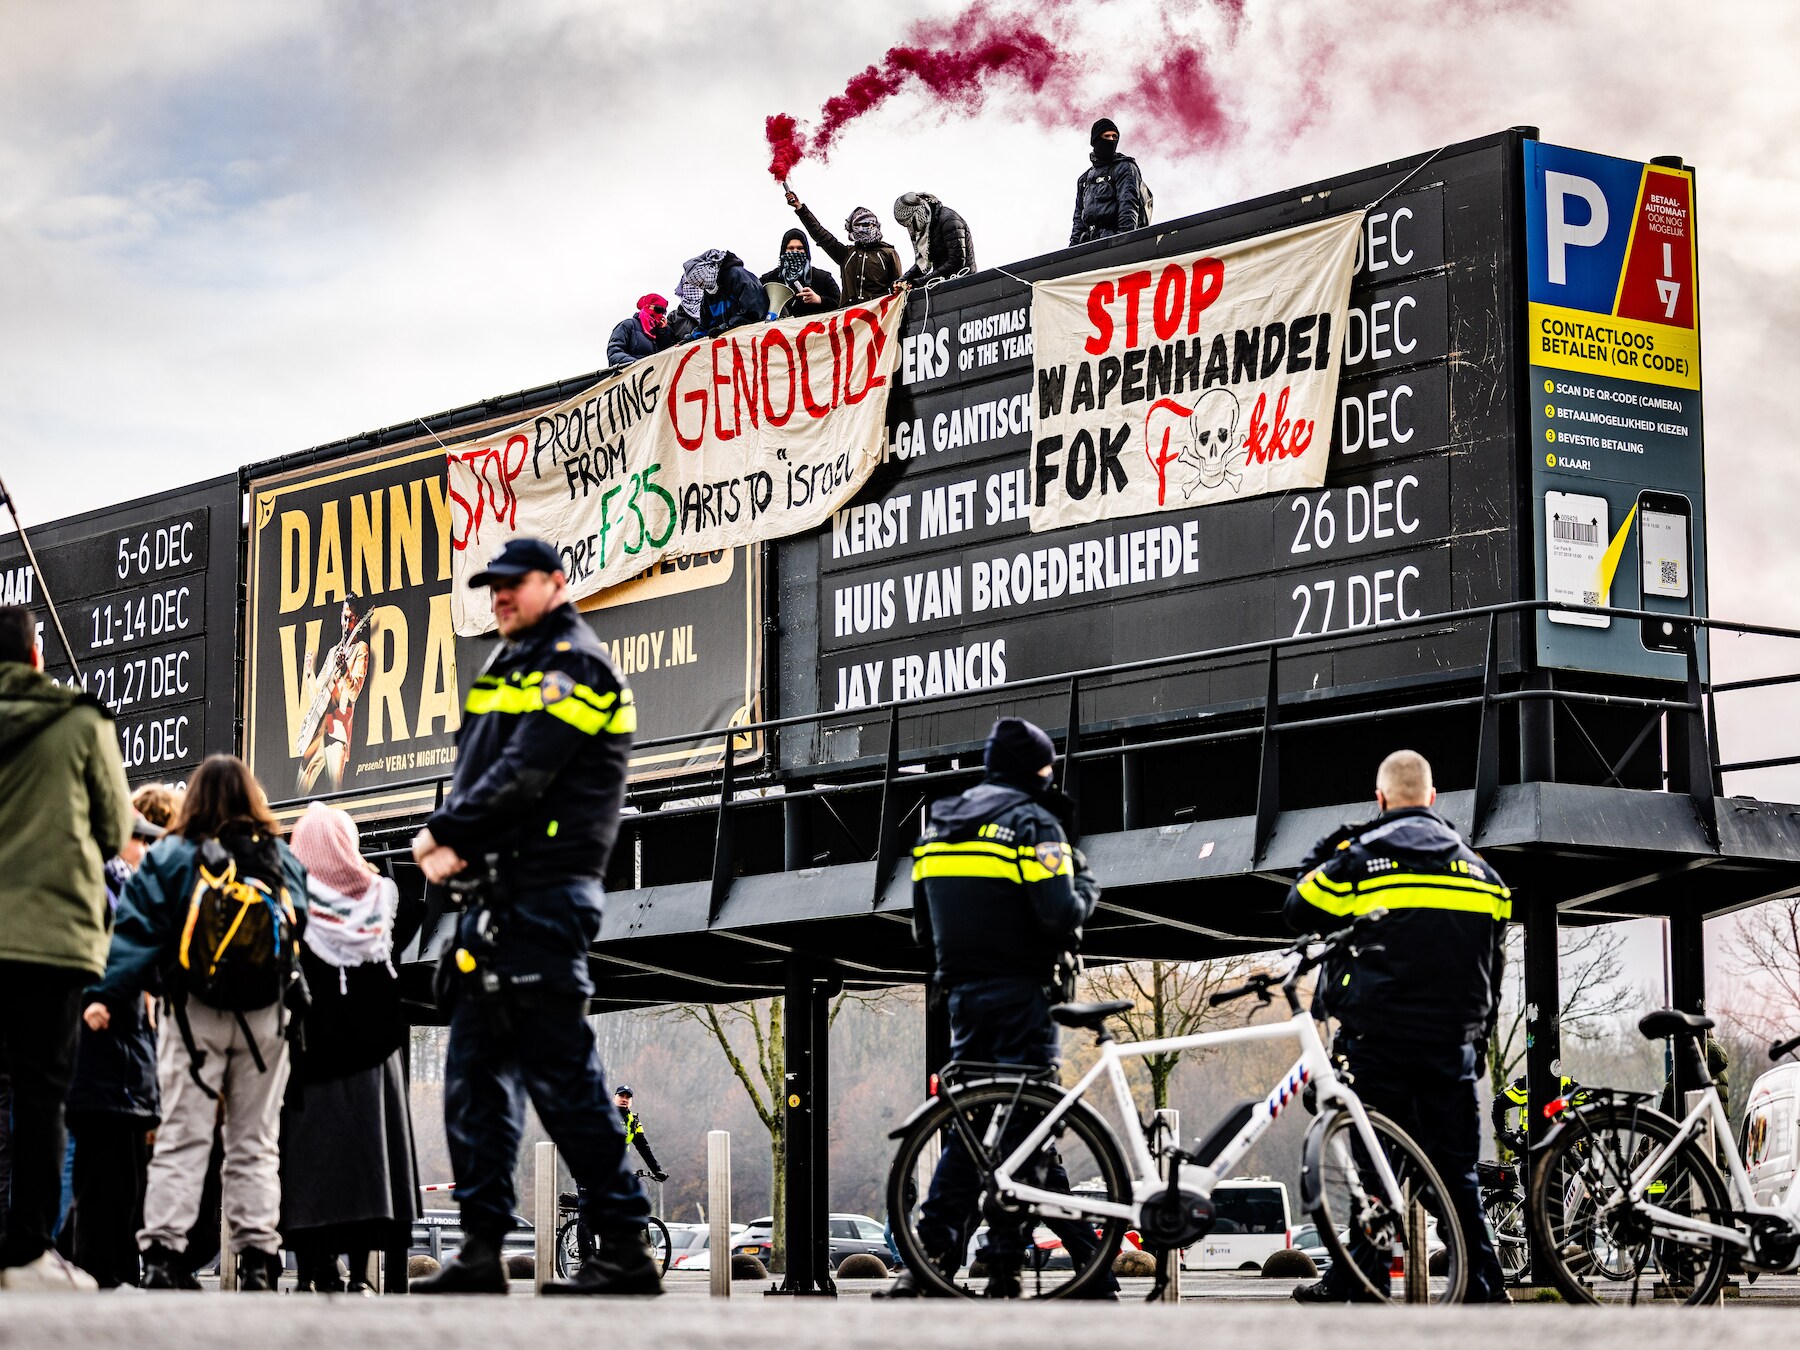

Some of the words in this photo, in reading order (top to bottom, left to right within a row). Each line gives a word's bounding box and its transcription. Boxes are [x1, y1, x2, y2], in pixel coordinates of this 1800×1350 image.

[1545, 170, 1609, 285] P
[1645, 203, 1686, 218] AUTOMAAT
[1648, 213, 1665, 224] OOK
[1666, 216, 1682, 227] NOG
[1649, 223, 1684, 237] MOGELIJK
[1650, 194, 1680, 208] BETAAL-
[958, 307, 1026, 344] CHRISTMAS
[1084, 257, 1225, 355] STOP
[1344, 295, 1417, 366] DEC
[1541, 318, 1654, 350] CONTACTLOOS
[958, 347, 974, 371] OF
[977, 341, 999, 367] THE
[1002, 333, 1033, 360] YEAR
[1038, 312, 1331, 419] WAPENHANDEL
[1542, 337, 1607, 361] BETALEN
[1612, 348, 1638, 366] (QR
[1643, 353, 1689, 377] CODE)
[1342, 384, 1414, 455] DEC
[1556, 383, 1581, 396] SCAN
[1583, 387, 1595, 398] DE
[1596, 390, 1637, 405] QR-CODE
[1639, 396, 1682, 413] (CAMERA)
[1557, 408, 1655, 432] BETAALMOGELIJKHEID
[1657, 421, 1688, 436] KIEZEN
[447, 434, 528, 551] STOP
[533, 366, 660, 479] PROFITING
[564, 434, 626, 500] FROM
[1035, 422, 1131, 506] FOK
[1558, 433, 1599, 448] BEVESTIG
[1601, 438, 1644, 454] BETALING
[1558, 457, 1591, 470] KLAAR!
[279, 475, 452, 614] DANNY
[555, 534, 598, 585] ORE
[600, 463, 677, 569] F-35
[744, 470, 773, 520] TO
[832, 495, 912, 559] KERST
[919, 478, 977, 540] MET
[985, 468, 1030, 526] SEL
[1291, 490, 1335, 554] 26
[1347, 475, 1419, 543] DEC
[117, 532, 150, 579] 5-6
[155, 522, 193, 570] DEC
[834, 578, 895, 638] HUIS
[904, 566, 962, 625] VAN
[971, 520, 1200, 613] BROEDERLIEFDE
[91, 596, 146, 649] 11-14
[151, 586, 189, 635] DEC
[1292, 580, 1335, 637] 27
[1348, 565, 1421, 629] DEC
[151, 650, 189, 699] DEC
[279, 593, 461, 758] VRA
[834, 661, 883, 711] JAY
[892, 639, 1006, 702] FRANCIS
[122, 723, 145, 768] 16
[150, 715, 188, 763] DEC
[356, 758, 384, 776] presents
[385, 753, 415, 772] VERA'S
